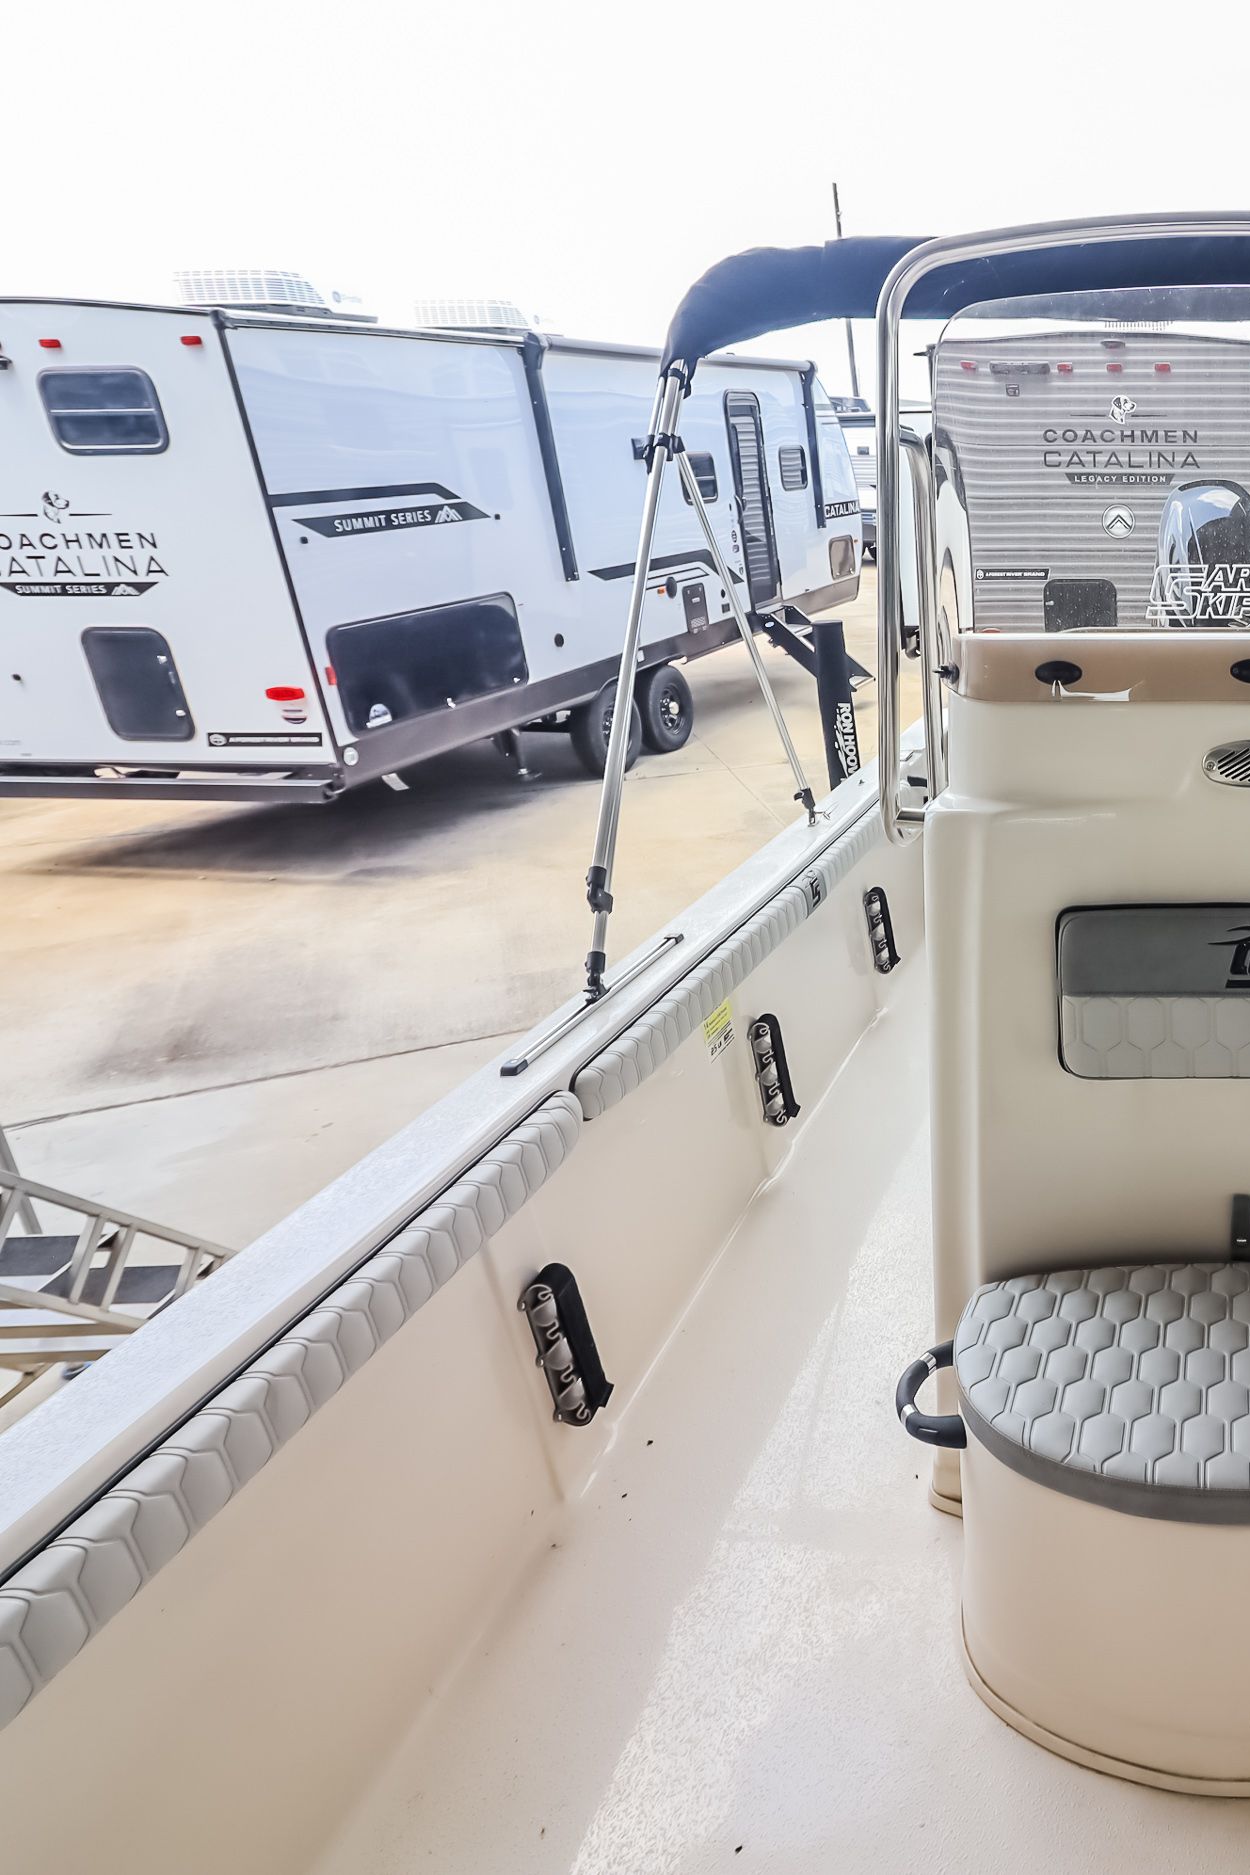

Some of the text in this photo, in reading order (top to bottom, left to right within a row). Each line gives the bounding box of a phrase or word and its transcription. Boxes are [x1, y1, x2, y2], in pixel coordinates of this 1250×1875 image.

[1043, 429, 1199, 443] COACHMEN
[1043, 451, 1201, 468] CATALINA
[1074, 475, 1166, 483] LEGACY EDITION
[824, 501, 860, 518] CATALINA
[334, 509, 432, 532] SUMMIT SERIES
[0, 533, 158, 550] OACHMEN
[0, 555, 169, 577] ATALINA
[15, 584, 107, 594] SUMMIT SERIES
[837, 702, 859, 775] RON HOOV
